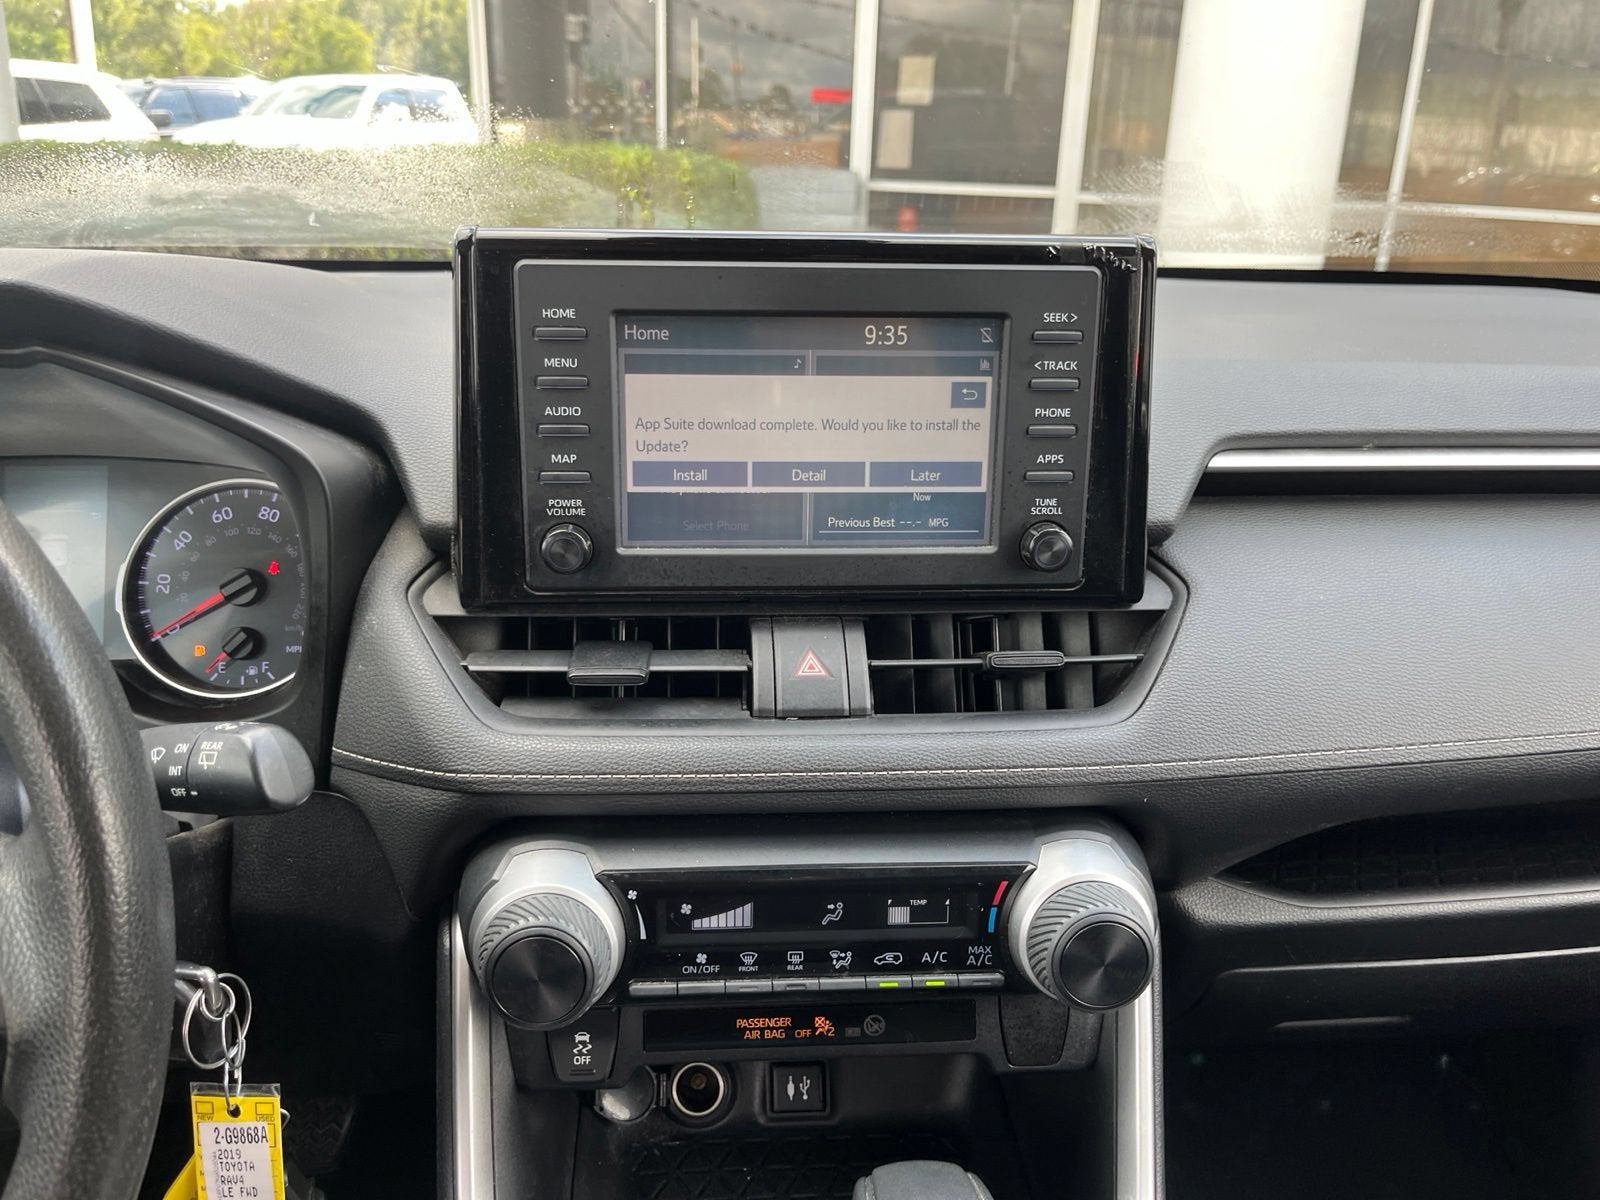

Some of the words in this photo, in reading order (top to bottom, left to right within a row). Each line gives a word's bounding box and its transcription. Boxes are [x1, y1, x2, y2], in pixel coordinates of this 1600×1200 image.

[542, 309, 576, 319] HOME
[624, 325, 670, 342] Home
[864, 325, 908, 346] 9:35
[544, 358, 578, 368] MENU
[544, 406, 582, 417] AUDIO
[1034, 408, 1072, 418] PHONE
[635, 417, 661, 432] App
[664, 418, 695, 430] Suite
[698, 418, 757, 431] download
[760, 418, 818, 432] complete.
[821, 419, 859, 431] Would
[862, 423, 884, 433] you
[887, 419, 907, 431] like
[910, 420, 923, 431] to
[926, 419, 959, 431] install
[962, 419, 981, 431] the
[635, 439, 689, 454] Update?
[551, 454, 578, 464] MAP
[1036, 454, 1065, 464] APPS
[673, 469, 708, 482] Install
[792, 469, 826, 482] Detail
[910, 470, 942, 482] Later
[913, 493, 931, 502] Now
[1035, 498, 1058, 507] TUNE
[549, 499, 583, 508] POWER
[212, 506, 233, 523] 60
[258, 506, 280, 523] 80
[546, 508, 587, 517] VOLUME
[1031, 507, 1063, 516] SCROLL
[682, 520, 713, 531] Select
[716, 520, 751, 531] Phone
[828, 517, 870, 528] Previous
[873, 517, 896, 528] Best
[928, 518, 949, 528] MPG
[174, 531, 192, 550] 40
[156, 574, 171, 594] 20
[219, 662, 226, 673] E
[262, 662, 270, 672] F
[174, 744, 189, 753] ON
[201, 742, 223, 750] REAR
[168, 766, 182, 776] INT
[170, 788, 186, 797] OFF
[968, 946, 992, 954] MAX
[922, 952, 948, 963] A/C
[966, 955, 993, 966] A/C
[682, 965, 720, 974] ON/OFF
[736, 1018, 792, 1028] PASSENGER
[744, 1030, 761, 1039] AIR
[764, 1030, 785, 1038] BAG
[795, 1029, 812, 1038] OFF
[574, 1056, 591, 1065] OFF
[214, 1126, 268, 1144] 2-G9868A
[217, 1149, 242, 1160] 2019
[219, 1161, 255, 1172] TOYOTA
[221, 1175, 244, 1185] RAV4
[222, 1187, 234, 1198] LE
[240, 1187, 258, 1198] FWD
